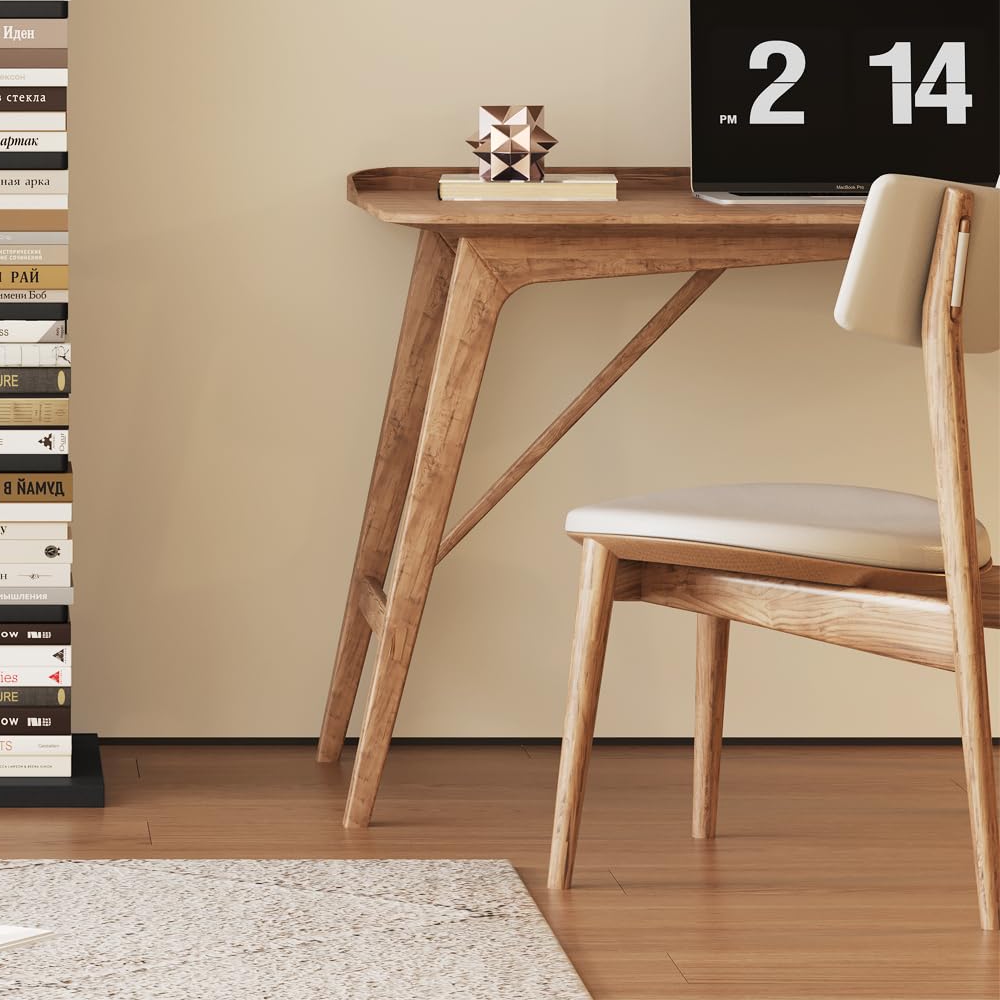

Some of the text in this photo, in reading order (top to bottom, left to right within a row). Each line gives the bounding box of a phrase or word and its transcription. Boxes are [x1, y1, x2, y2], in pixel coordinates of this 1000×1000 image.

[3, 26, 35, 40] Иден
[749, 40, 806, 125] 2
[868, 41, 973, 125] 14
[6, 94, 46, 102] стекла
[719, 115, 738, 124] PM
[25, 179, 50, 188] арка
[11, 268, 39, 283] РАЙ
[29, 291, 47, 300] Боб
